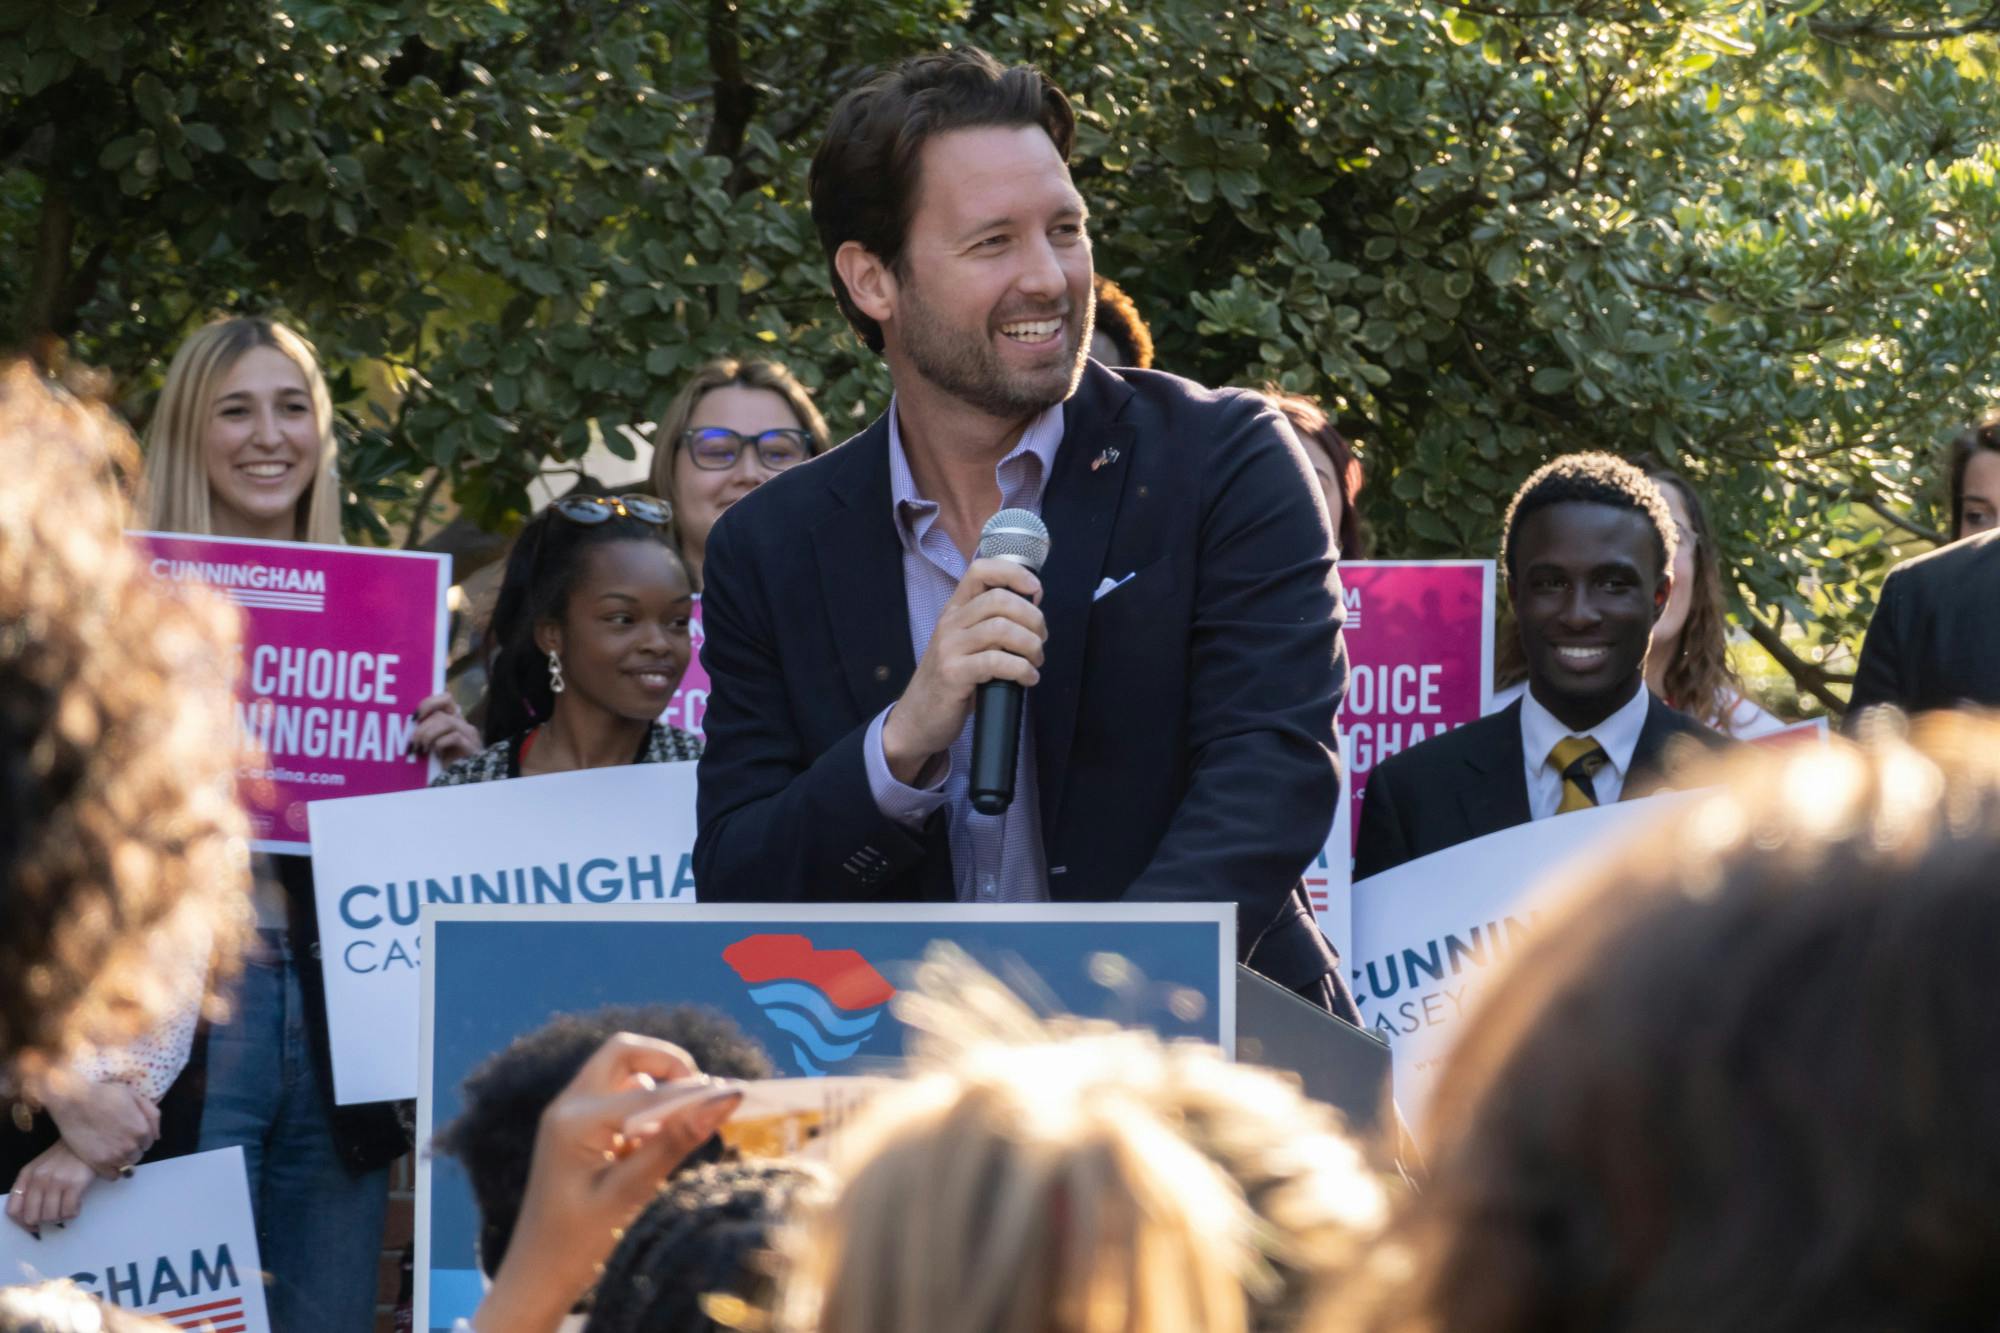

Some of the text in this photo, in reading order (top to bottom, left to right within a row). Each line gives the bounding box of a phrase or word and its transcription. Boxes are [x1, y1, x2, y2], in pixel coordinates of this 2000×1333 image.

[150, 558, 325, 593] CUNNINGHAM
[252, 644, 401, 704] CHOICE
[1338, 664, 1443, 716] OICE
